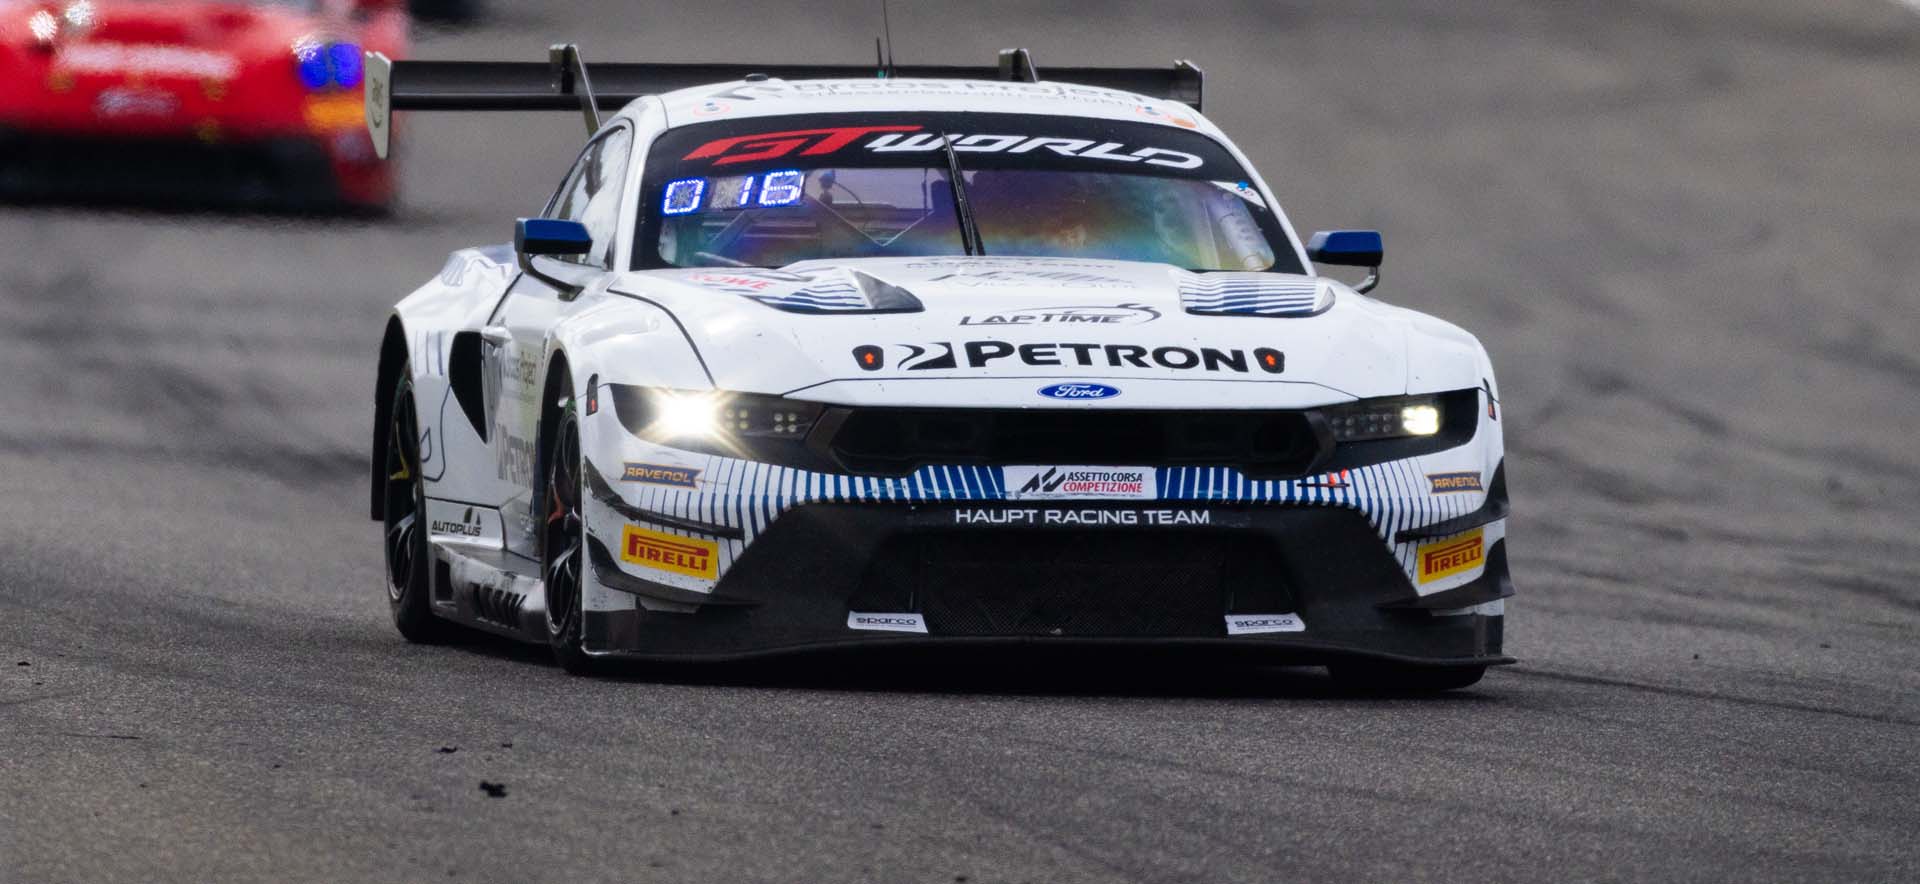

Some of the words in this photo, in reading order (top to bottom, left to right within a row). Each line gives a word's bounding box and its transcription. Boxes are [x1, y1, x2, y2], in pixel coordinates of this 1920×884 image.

[964, 341, 1250, 373] PETRON
[1053, 384, 1105, 398] Ford
[626, 467, 692, 483] RAVENOL
[1067, 471, 1110, 482] ASSETTO
[1111, 472, 1143, 482] CORSA
[1062, 482, 1143, 493] COMPETIZIONE
[955, 508, 1038, 524] HAUPT
[1044, 509, 1138, 524] RACING
[1143, 509, 1210, 525] TEAM
[432, 519, 482, 537] AUTOPLUS
[628, 533, 710, 572] PIRELLI
[1424, 535, 1482, 576] PIRELLI
[855, 617, 917, 626] sparco
